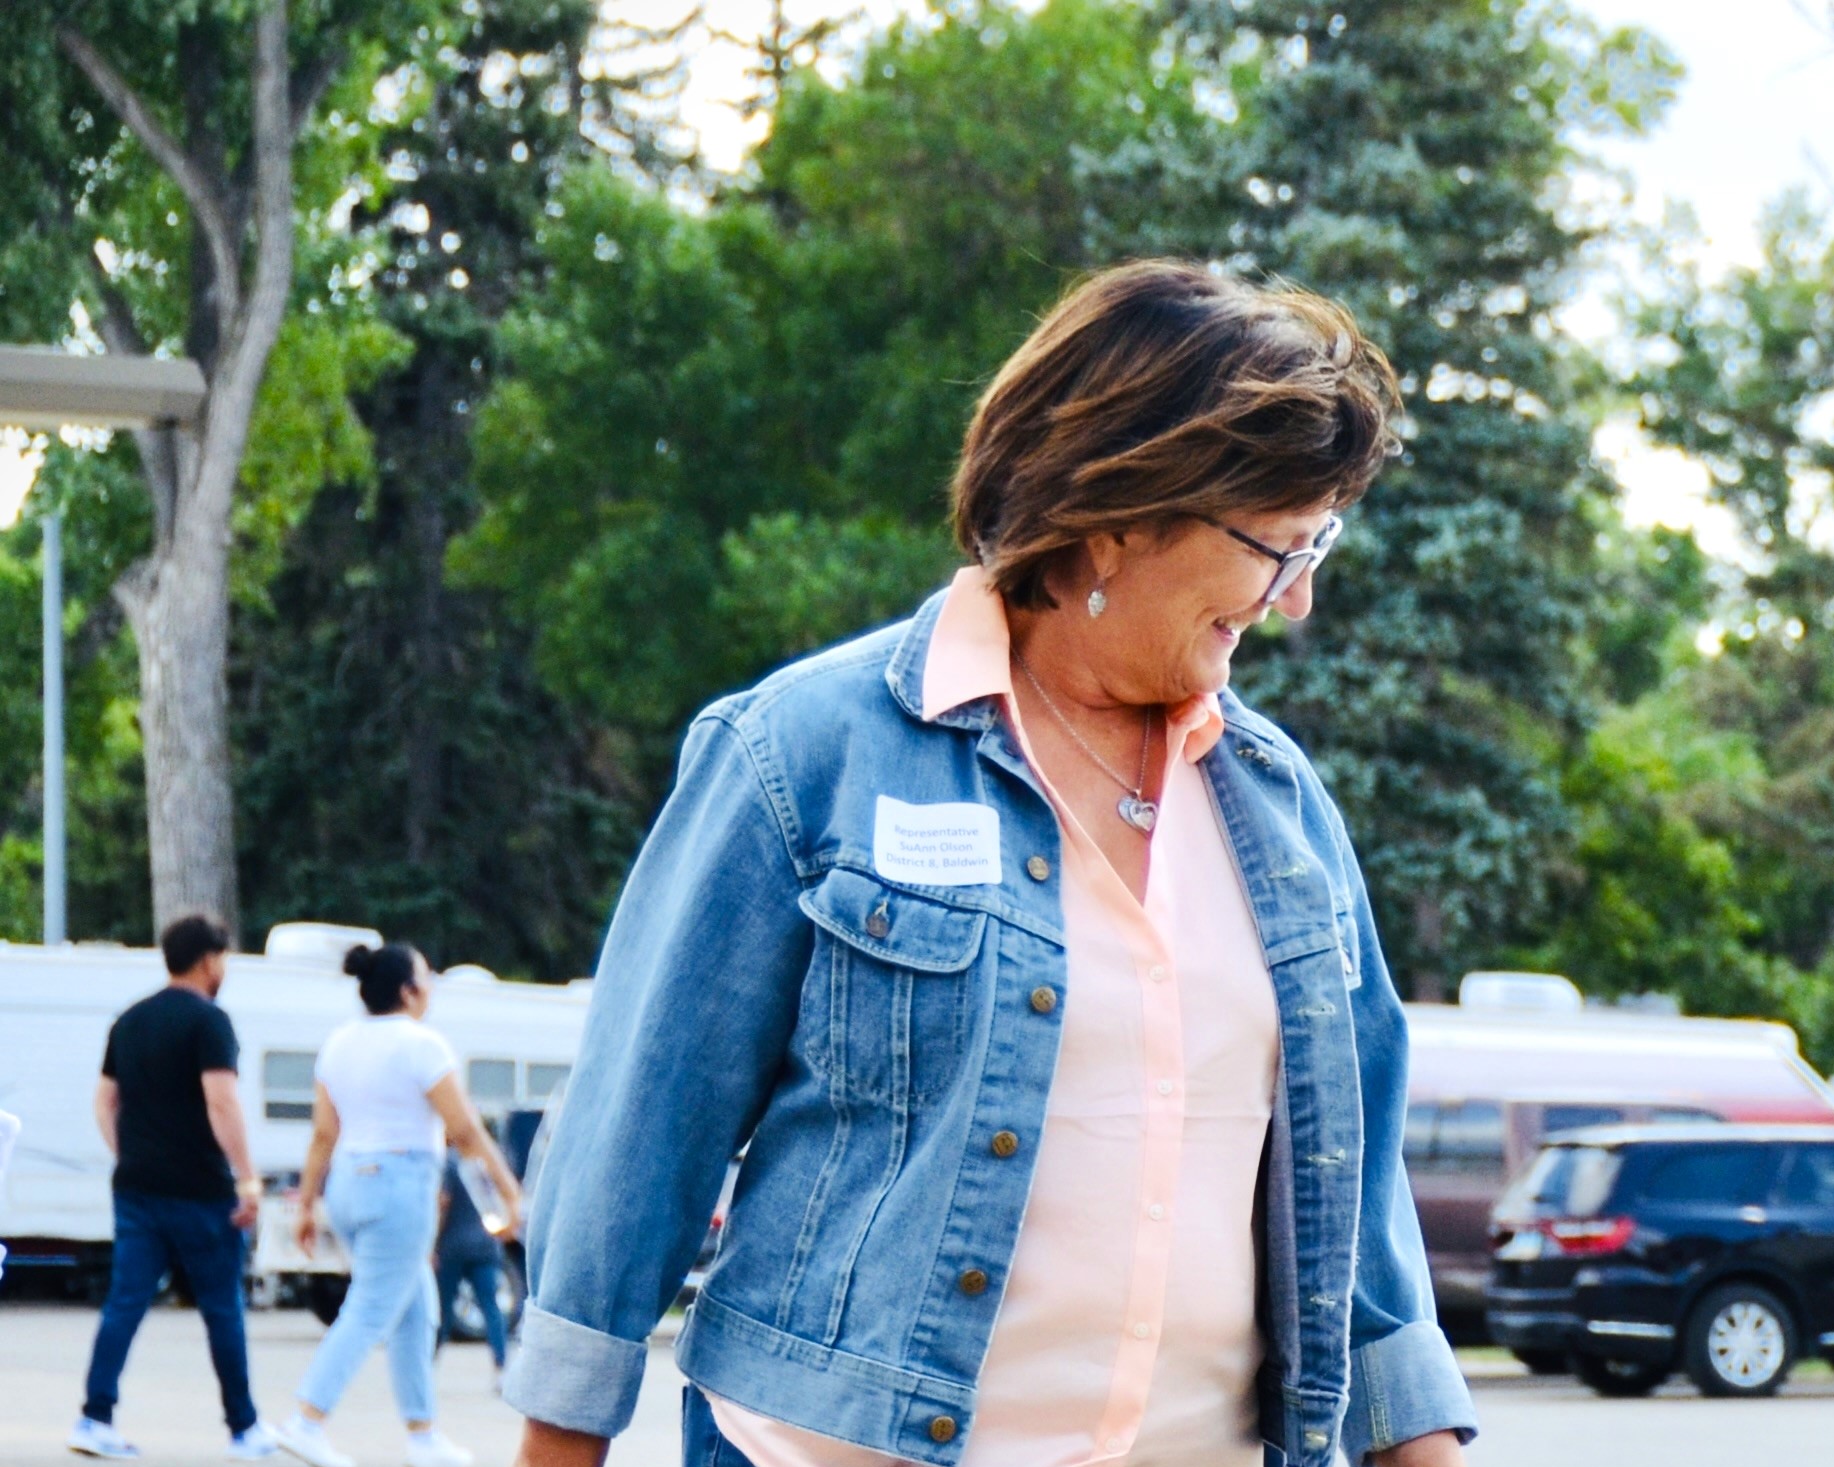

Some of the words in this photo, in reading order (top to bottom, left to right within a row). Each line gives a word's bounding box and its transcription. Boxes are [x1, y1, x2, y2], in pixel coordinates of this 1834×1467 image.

[894, 823, 979, 838] Representative
[899, 841, 937, 853] SuAnn
[939, 842, 973, 852] Olson
[886, 852, 925, 868] District
[943, 857, 989, 868] Baldwin
